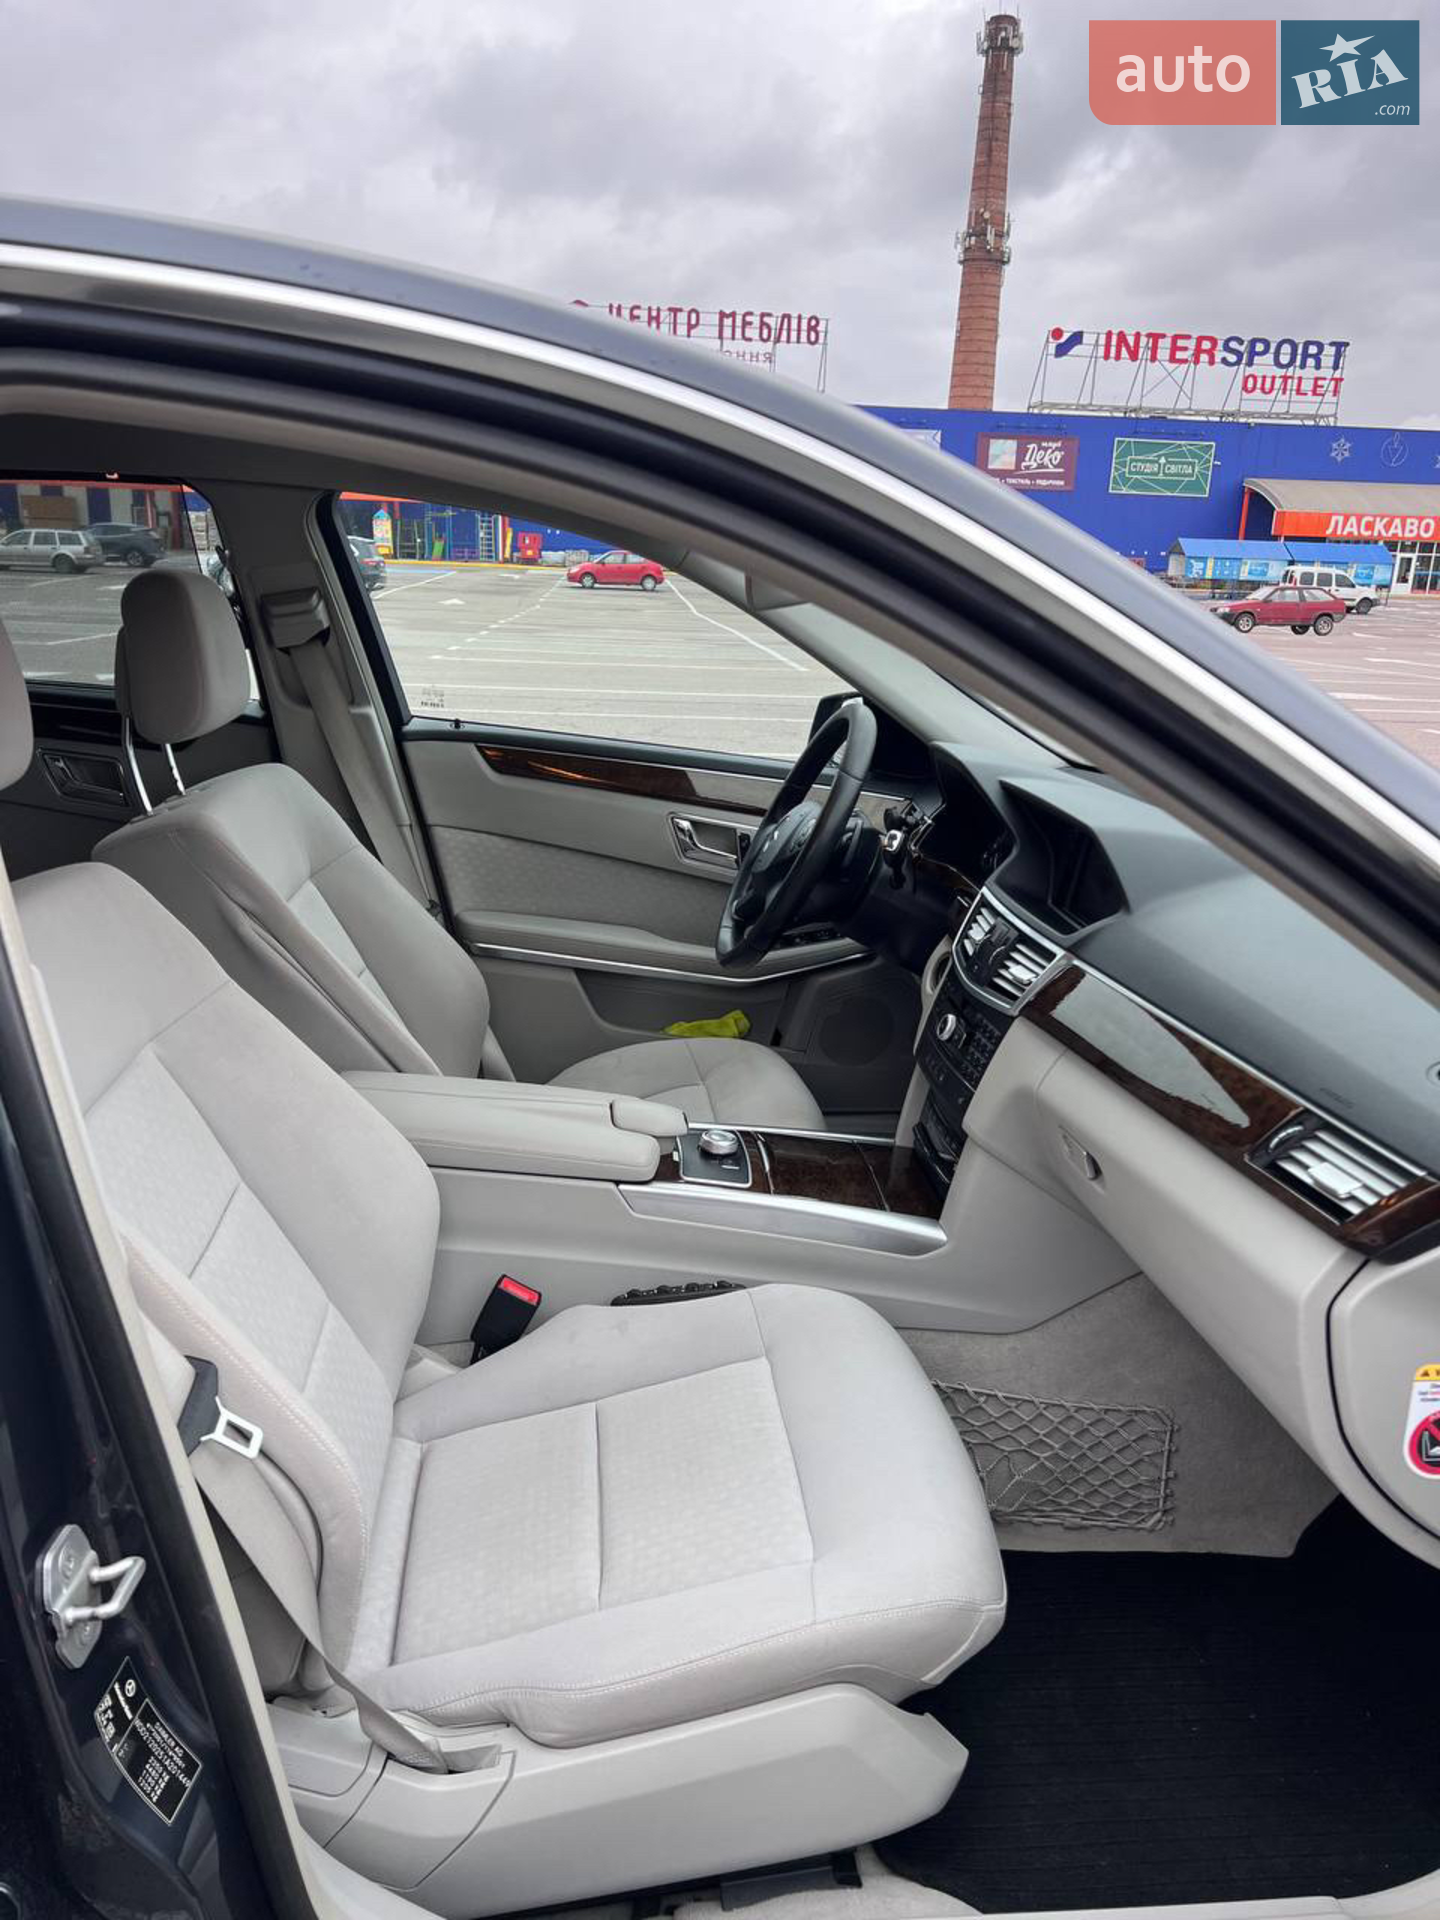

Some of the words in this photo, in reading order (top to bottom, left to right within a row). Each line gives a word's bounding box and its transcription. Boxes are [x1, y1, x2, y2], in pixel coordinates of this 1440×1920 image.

[718, 310, 820, 345] МЕБЛІВ
[1103, 329, 1350, 371] INTERSPORT
[1241, 373, 1344, 397] OUTLET
[1130, 462, 1159, 473] СТУДІЯ
[1165, 464, 1192, 474] СВІТЛА
[1326, 515, 1435, 538] ЛАСКАВО
